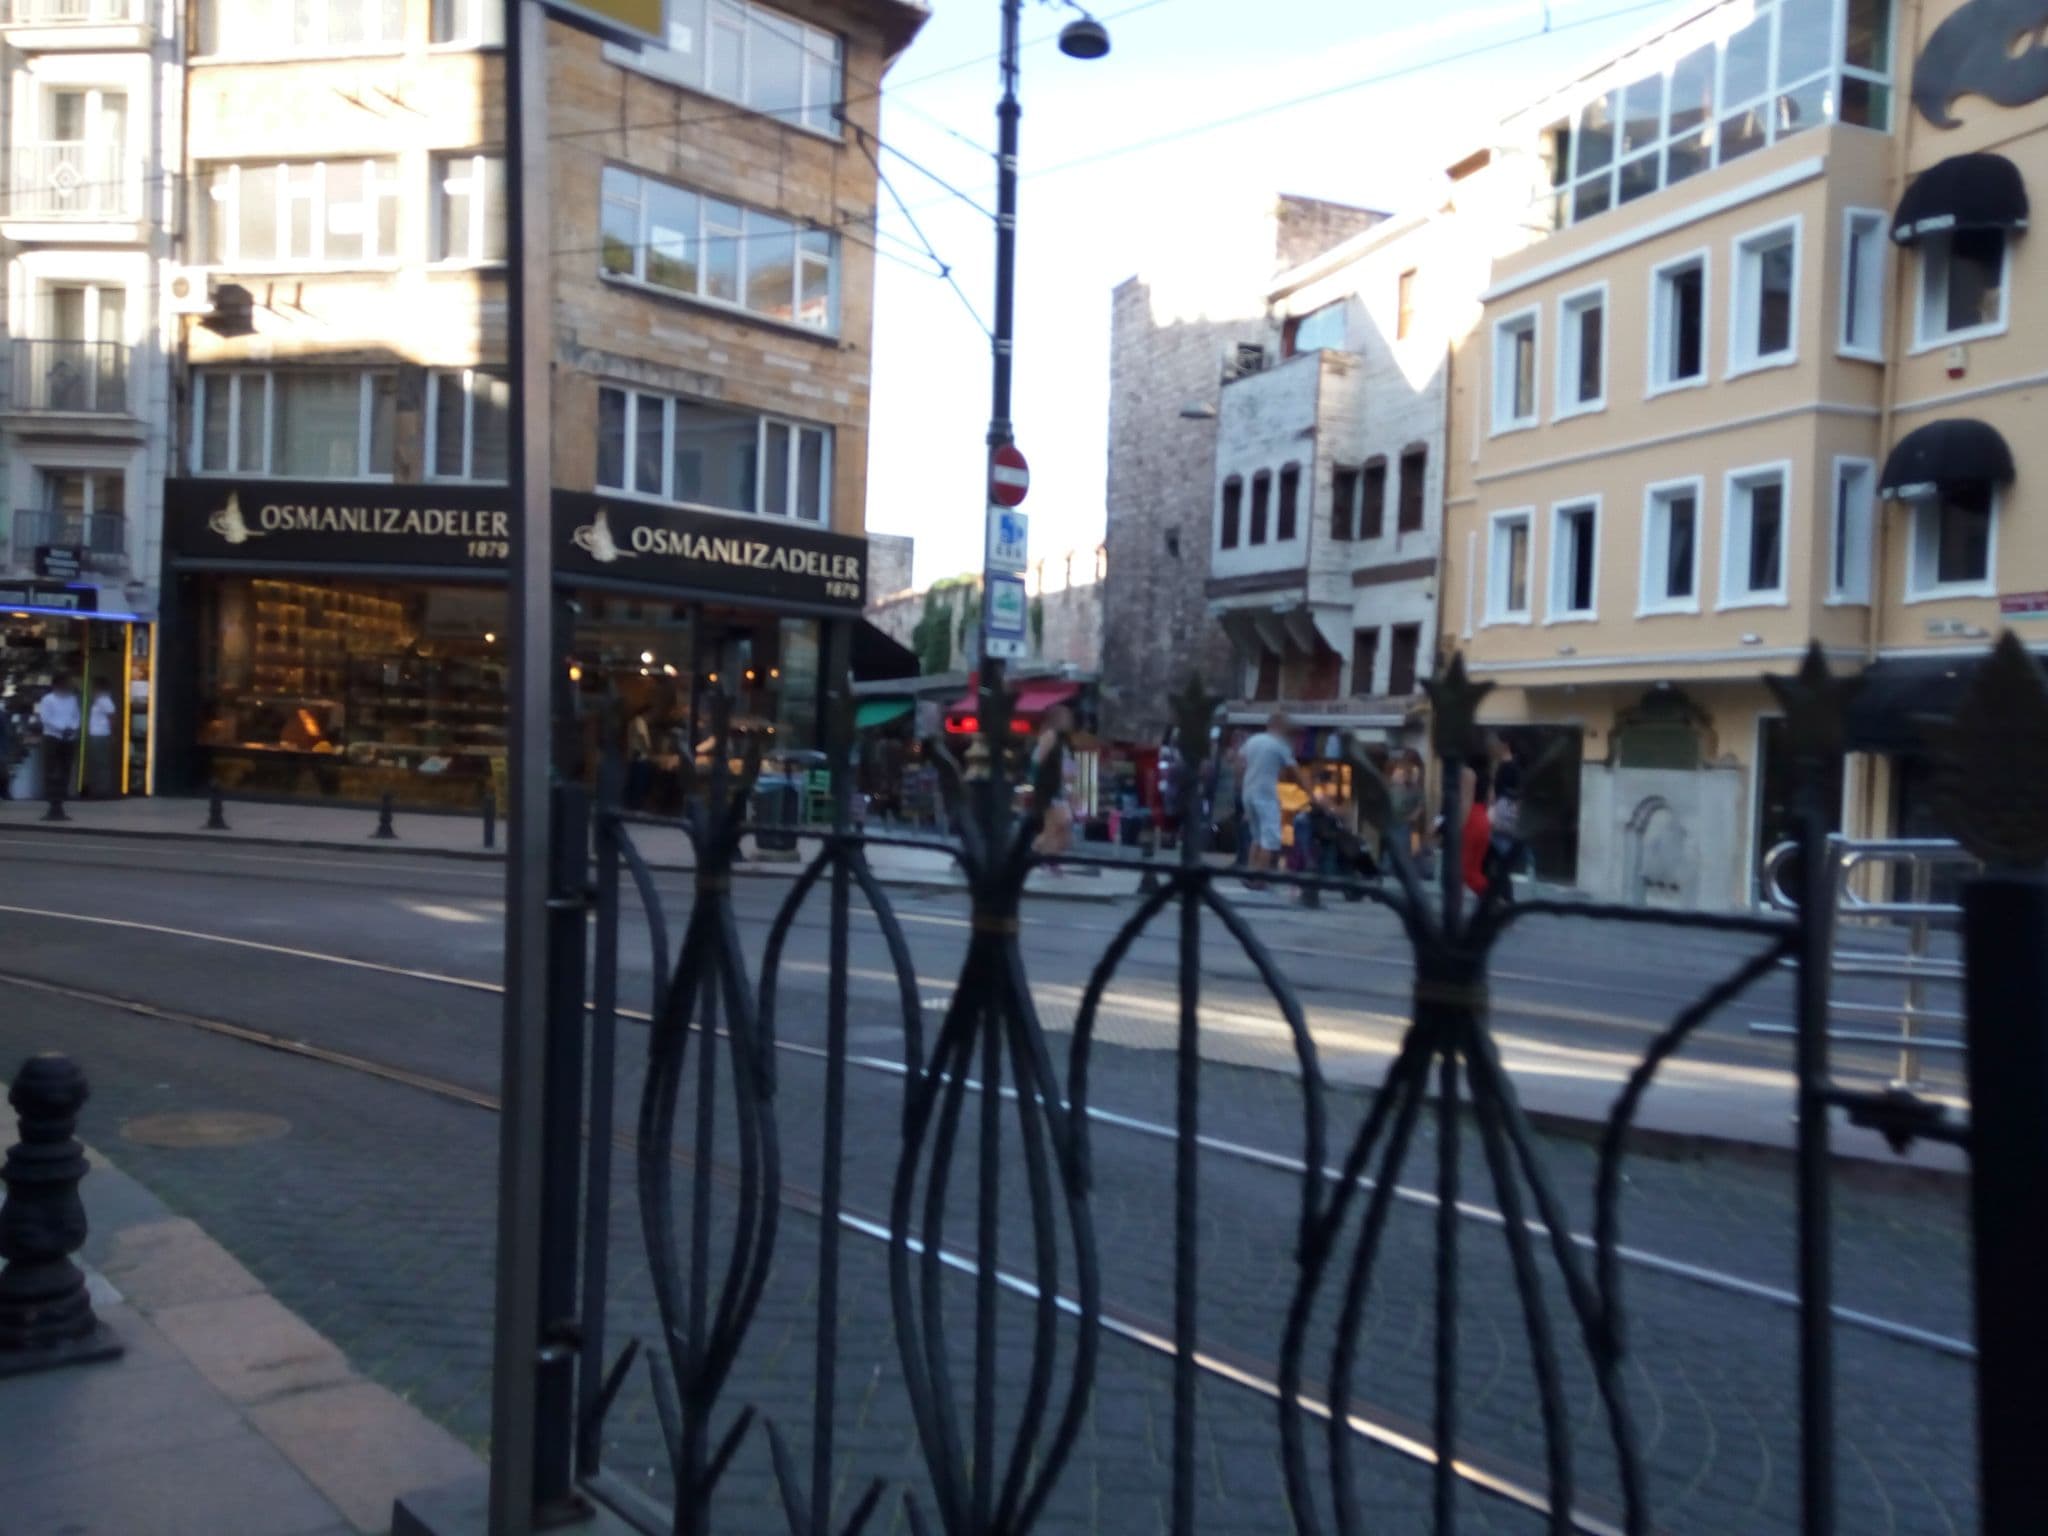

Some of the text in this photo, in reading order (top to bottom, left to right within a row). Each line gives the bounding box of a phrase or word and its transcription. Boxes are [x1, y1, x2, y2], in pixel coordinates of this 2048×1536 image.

[260, 505, 509, 536] OSMANLIZADELER
[467, 541, 510, 558] 1879
[631, 526, 860, 580] OSMANLIZADELER
